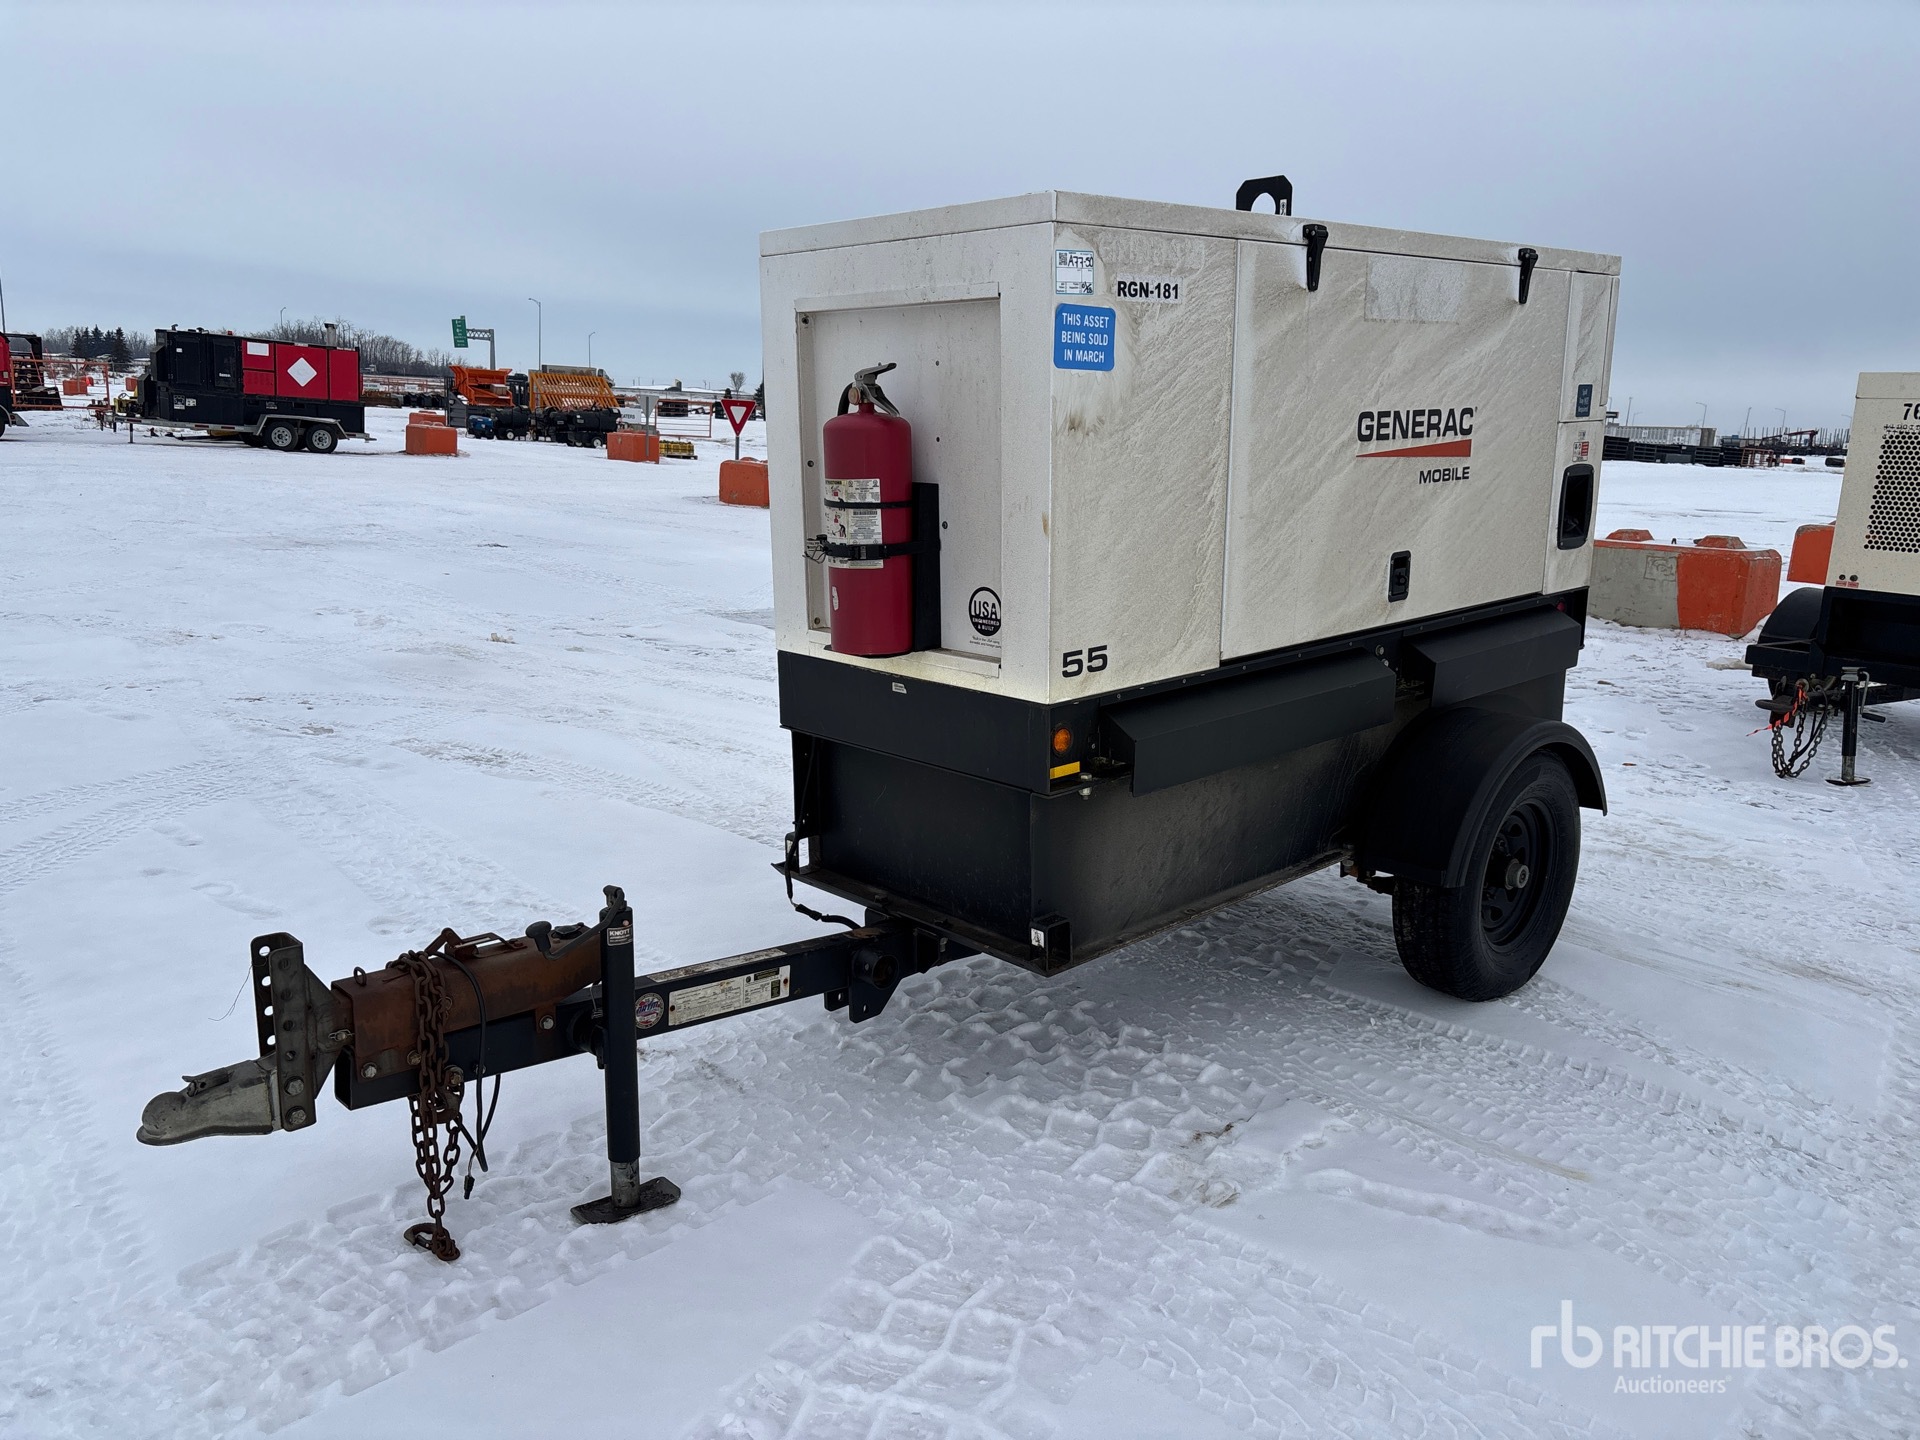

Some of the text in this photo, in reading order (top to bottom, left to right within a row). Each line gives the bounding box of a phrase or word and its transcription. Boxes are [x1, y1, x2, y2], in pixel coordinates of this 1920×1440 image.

[1117, 280, 1179, 300] RGN-181
[1062, 312, 1109, 329] THIS ASSET
[1061, 330, 1109, 346] BEING SOLD
[1064, 348, 1105, 363] IN MARCH
[1357, 407, 1474, 442] GENERAC
[1418, 466, 1470, 484] MOBILE
[973, 599, 998, 620] USA
[1062, 644, 1108, 678] 55
[609, 928, 630, 937] KNOTT
